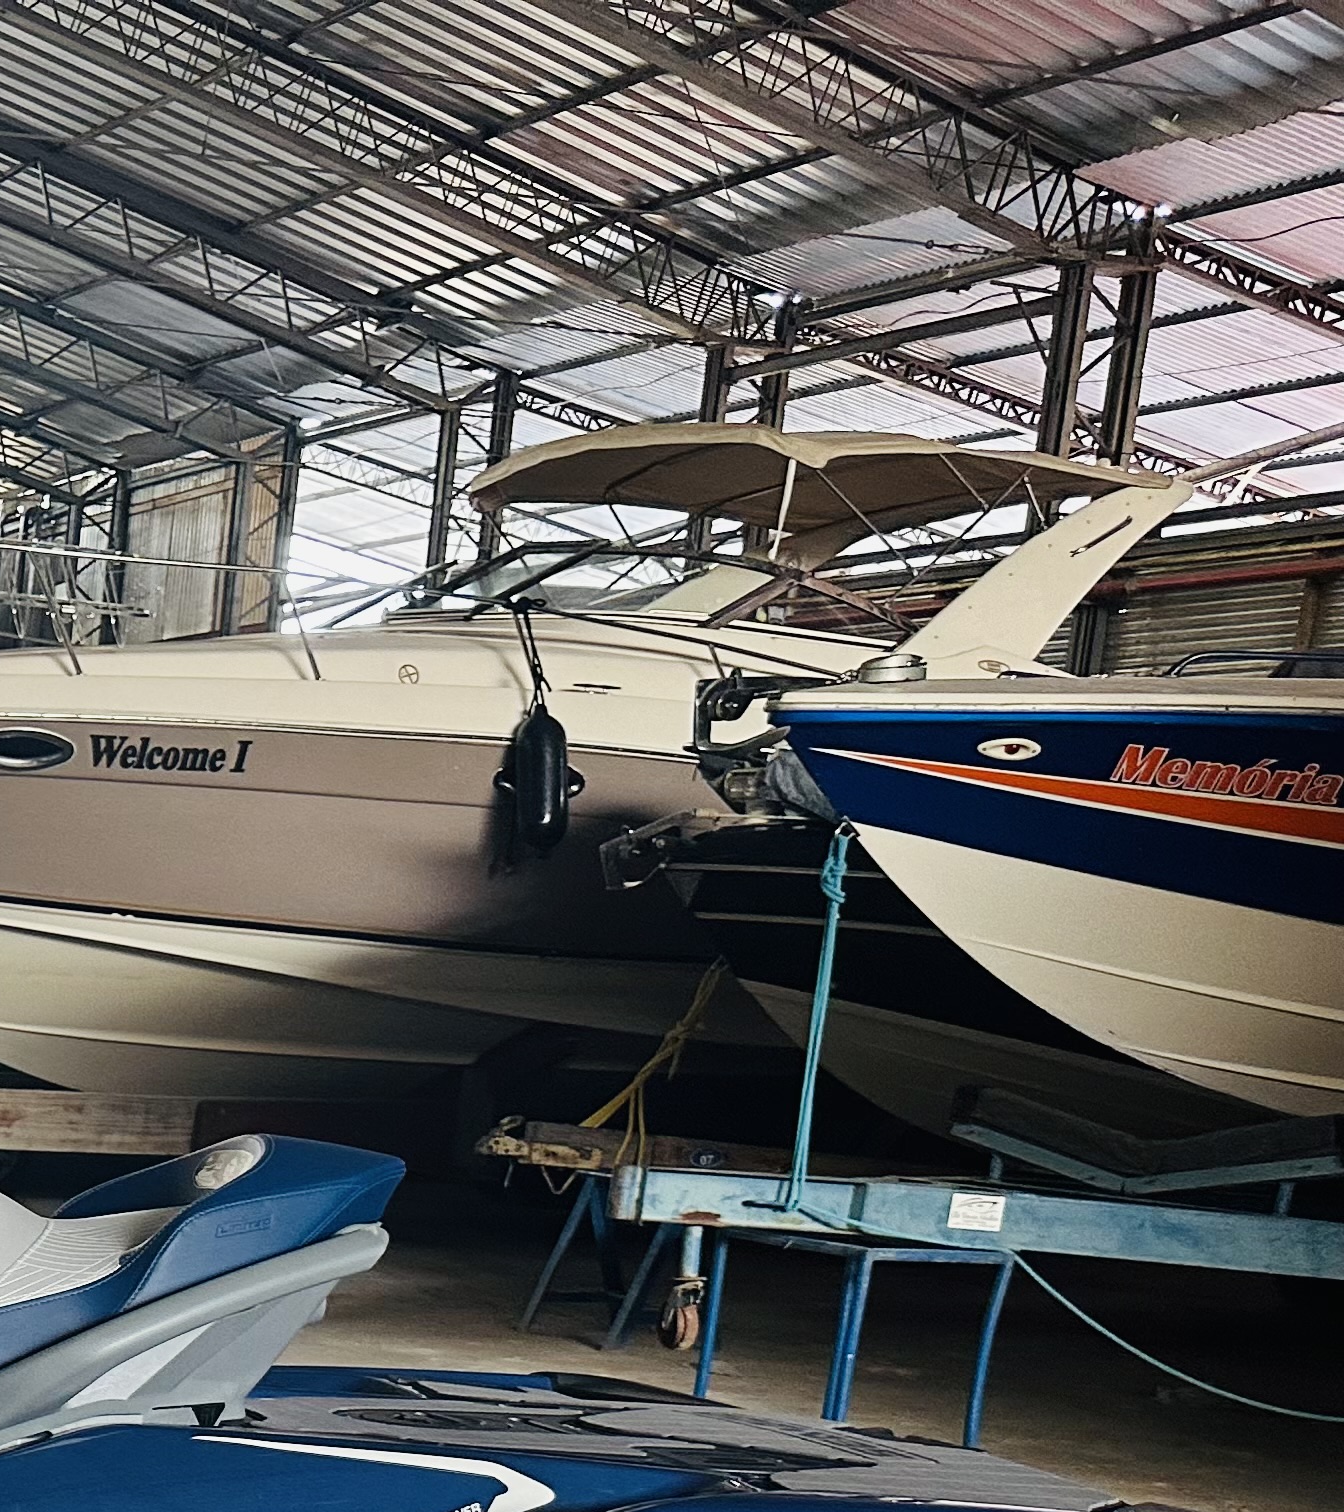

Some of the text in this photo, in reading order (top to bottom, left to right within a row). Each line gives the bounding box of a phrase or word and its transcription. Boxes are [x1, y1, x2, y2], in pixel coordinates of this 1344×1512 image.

[89, 734, 254, 773] Welcome I
[1109, 743, 1344, 806] Memória
